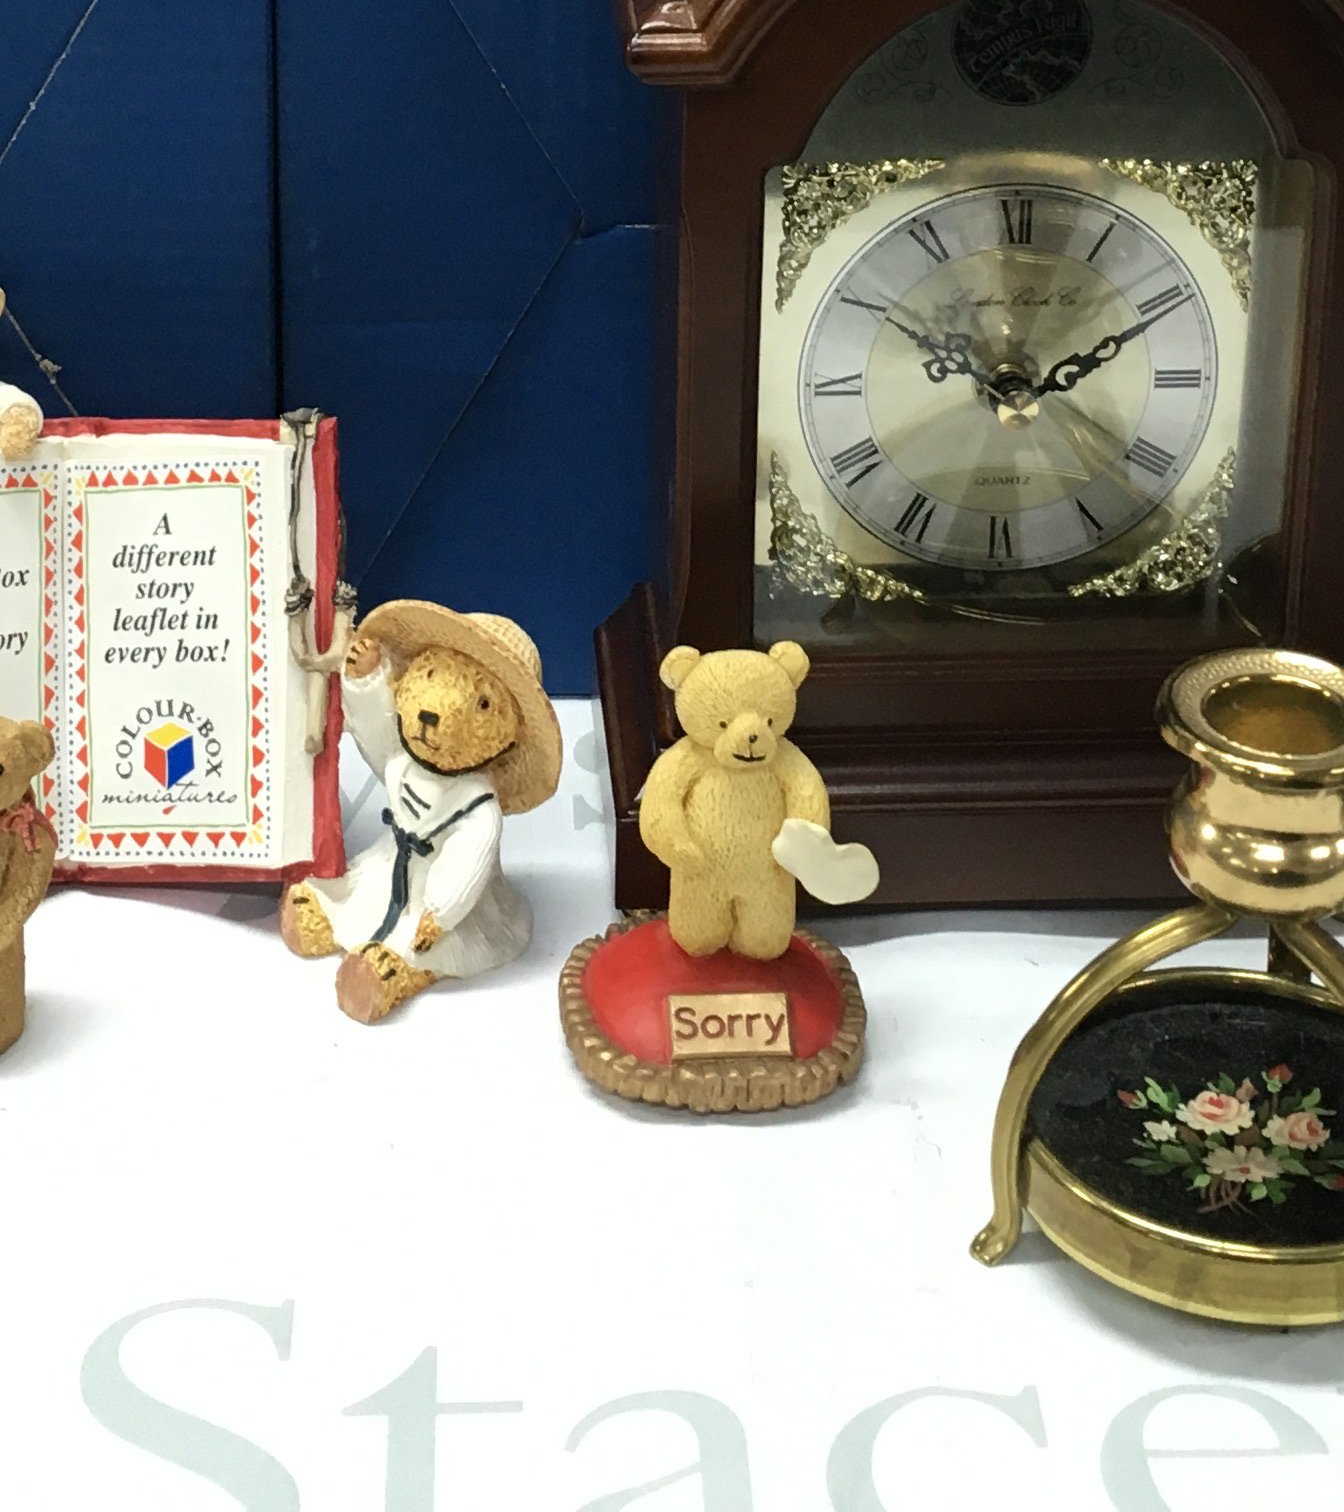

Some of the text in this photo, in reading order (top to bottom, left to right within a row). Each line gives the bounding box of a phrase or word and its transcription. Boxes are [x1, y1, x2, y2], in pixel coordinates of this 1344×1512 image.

[974, 474, 1032, 487] QUARTZ
[152, 511, 172, 536] A
[112, 543, 217, 574] different
[135, 578, 195, 605] story
[113, 606, 219, 637] leaflet in
[104, 638, 231, 669] every box!
[102, 780, 238, 804] miniatures
[674, 1006, 785, 1046] Sorry
